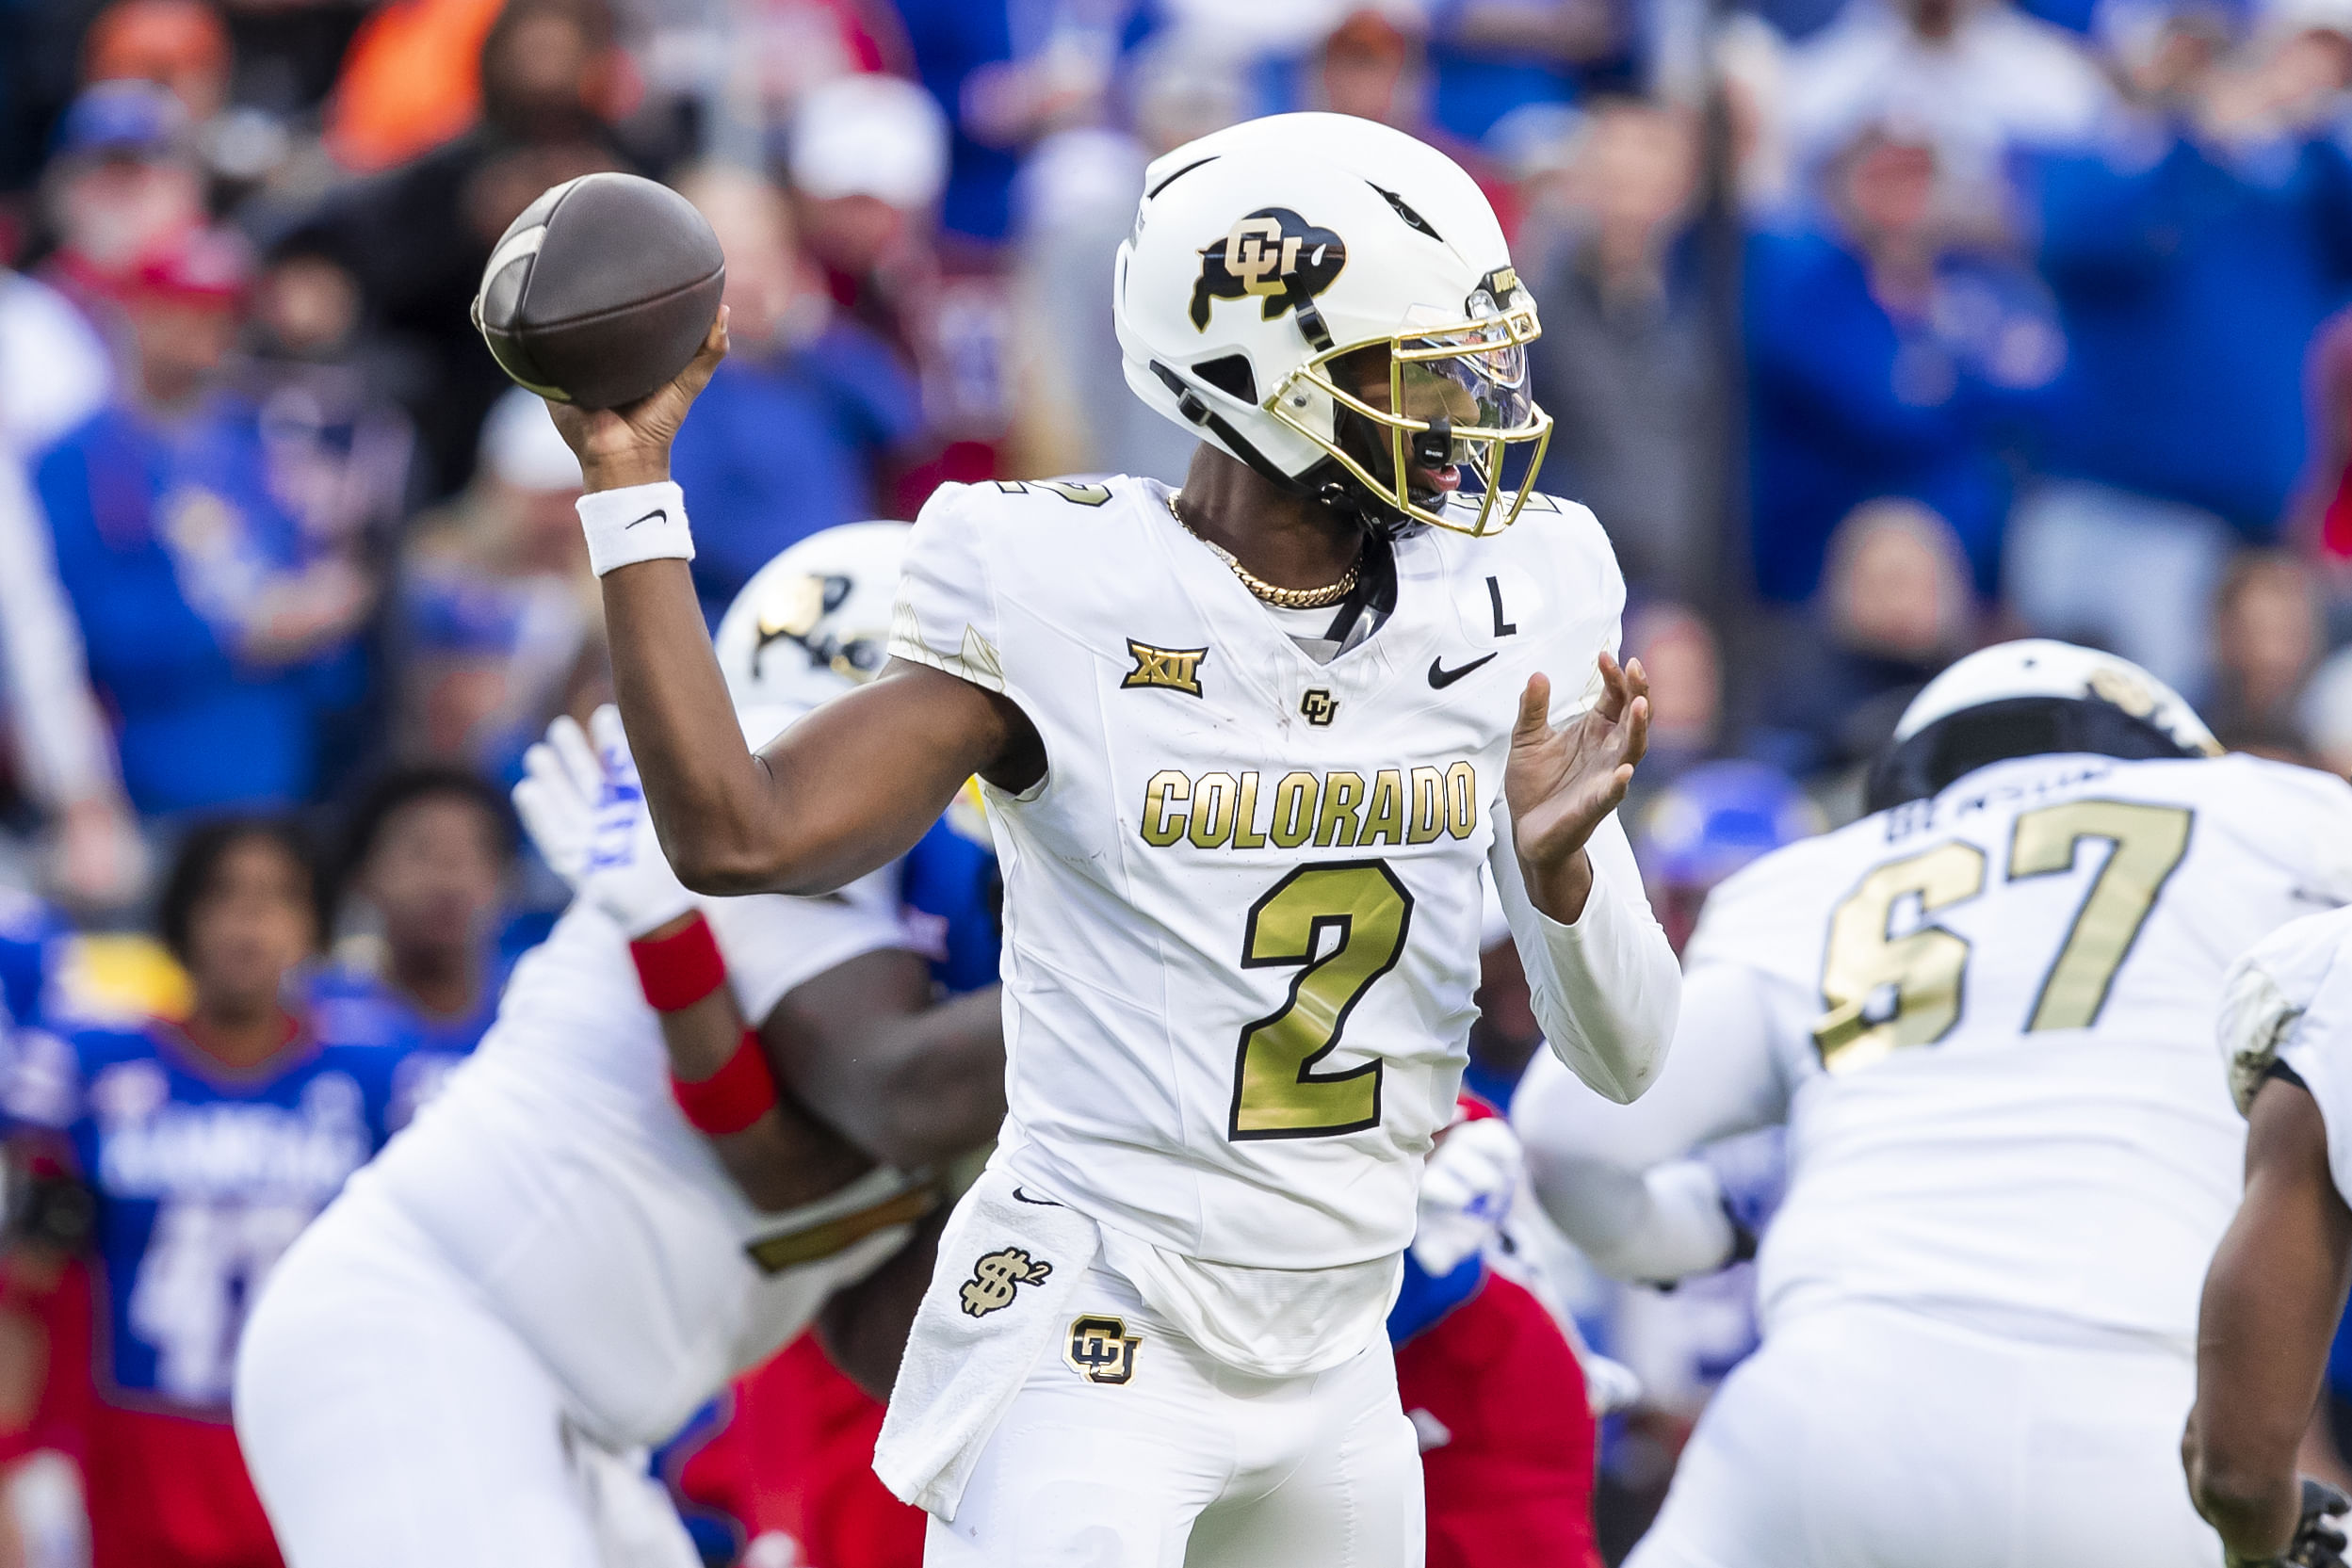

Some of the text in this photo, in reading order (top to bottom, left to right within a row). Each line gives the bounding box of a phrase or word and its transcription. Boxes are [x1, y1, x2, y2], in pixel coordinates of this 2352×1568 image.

[1225, 217, 1303, 296] CU
[1485, 575, 1517, 638] L
[1124, 640, 1206, 696] XII
[1301, 687, 1340, 727] CU
[1141, 761, 1477, 849] COLORADO
[1811, 798, 2195, 1074] 67
[1228, 858, 1415, 1142] 2
[1064, 1314, 1143, 1385] CU
